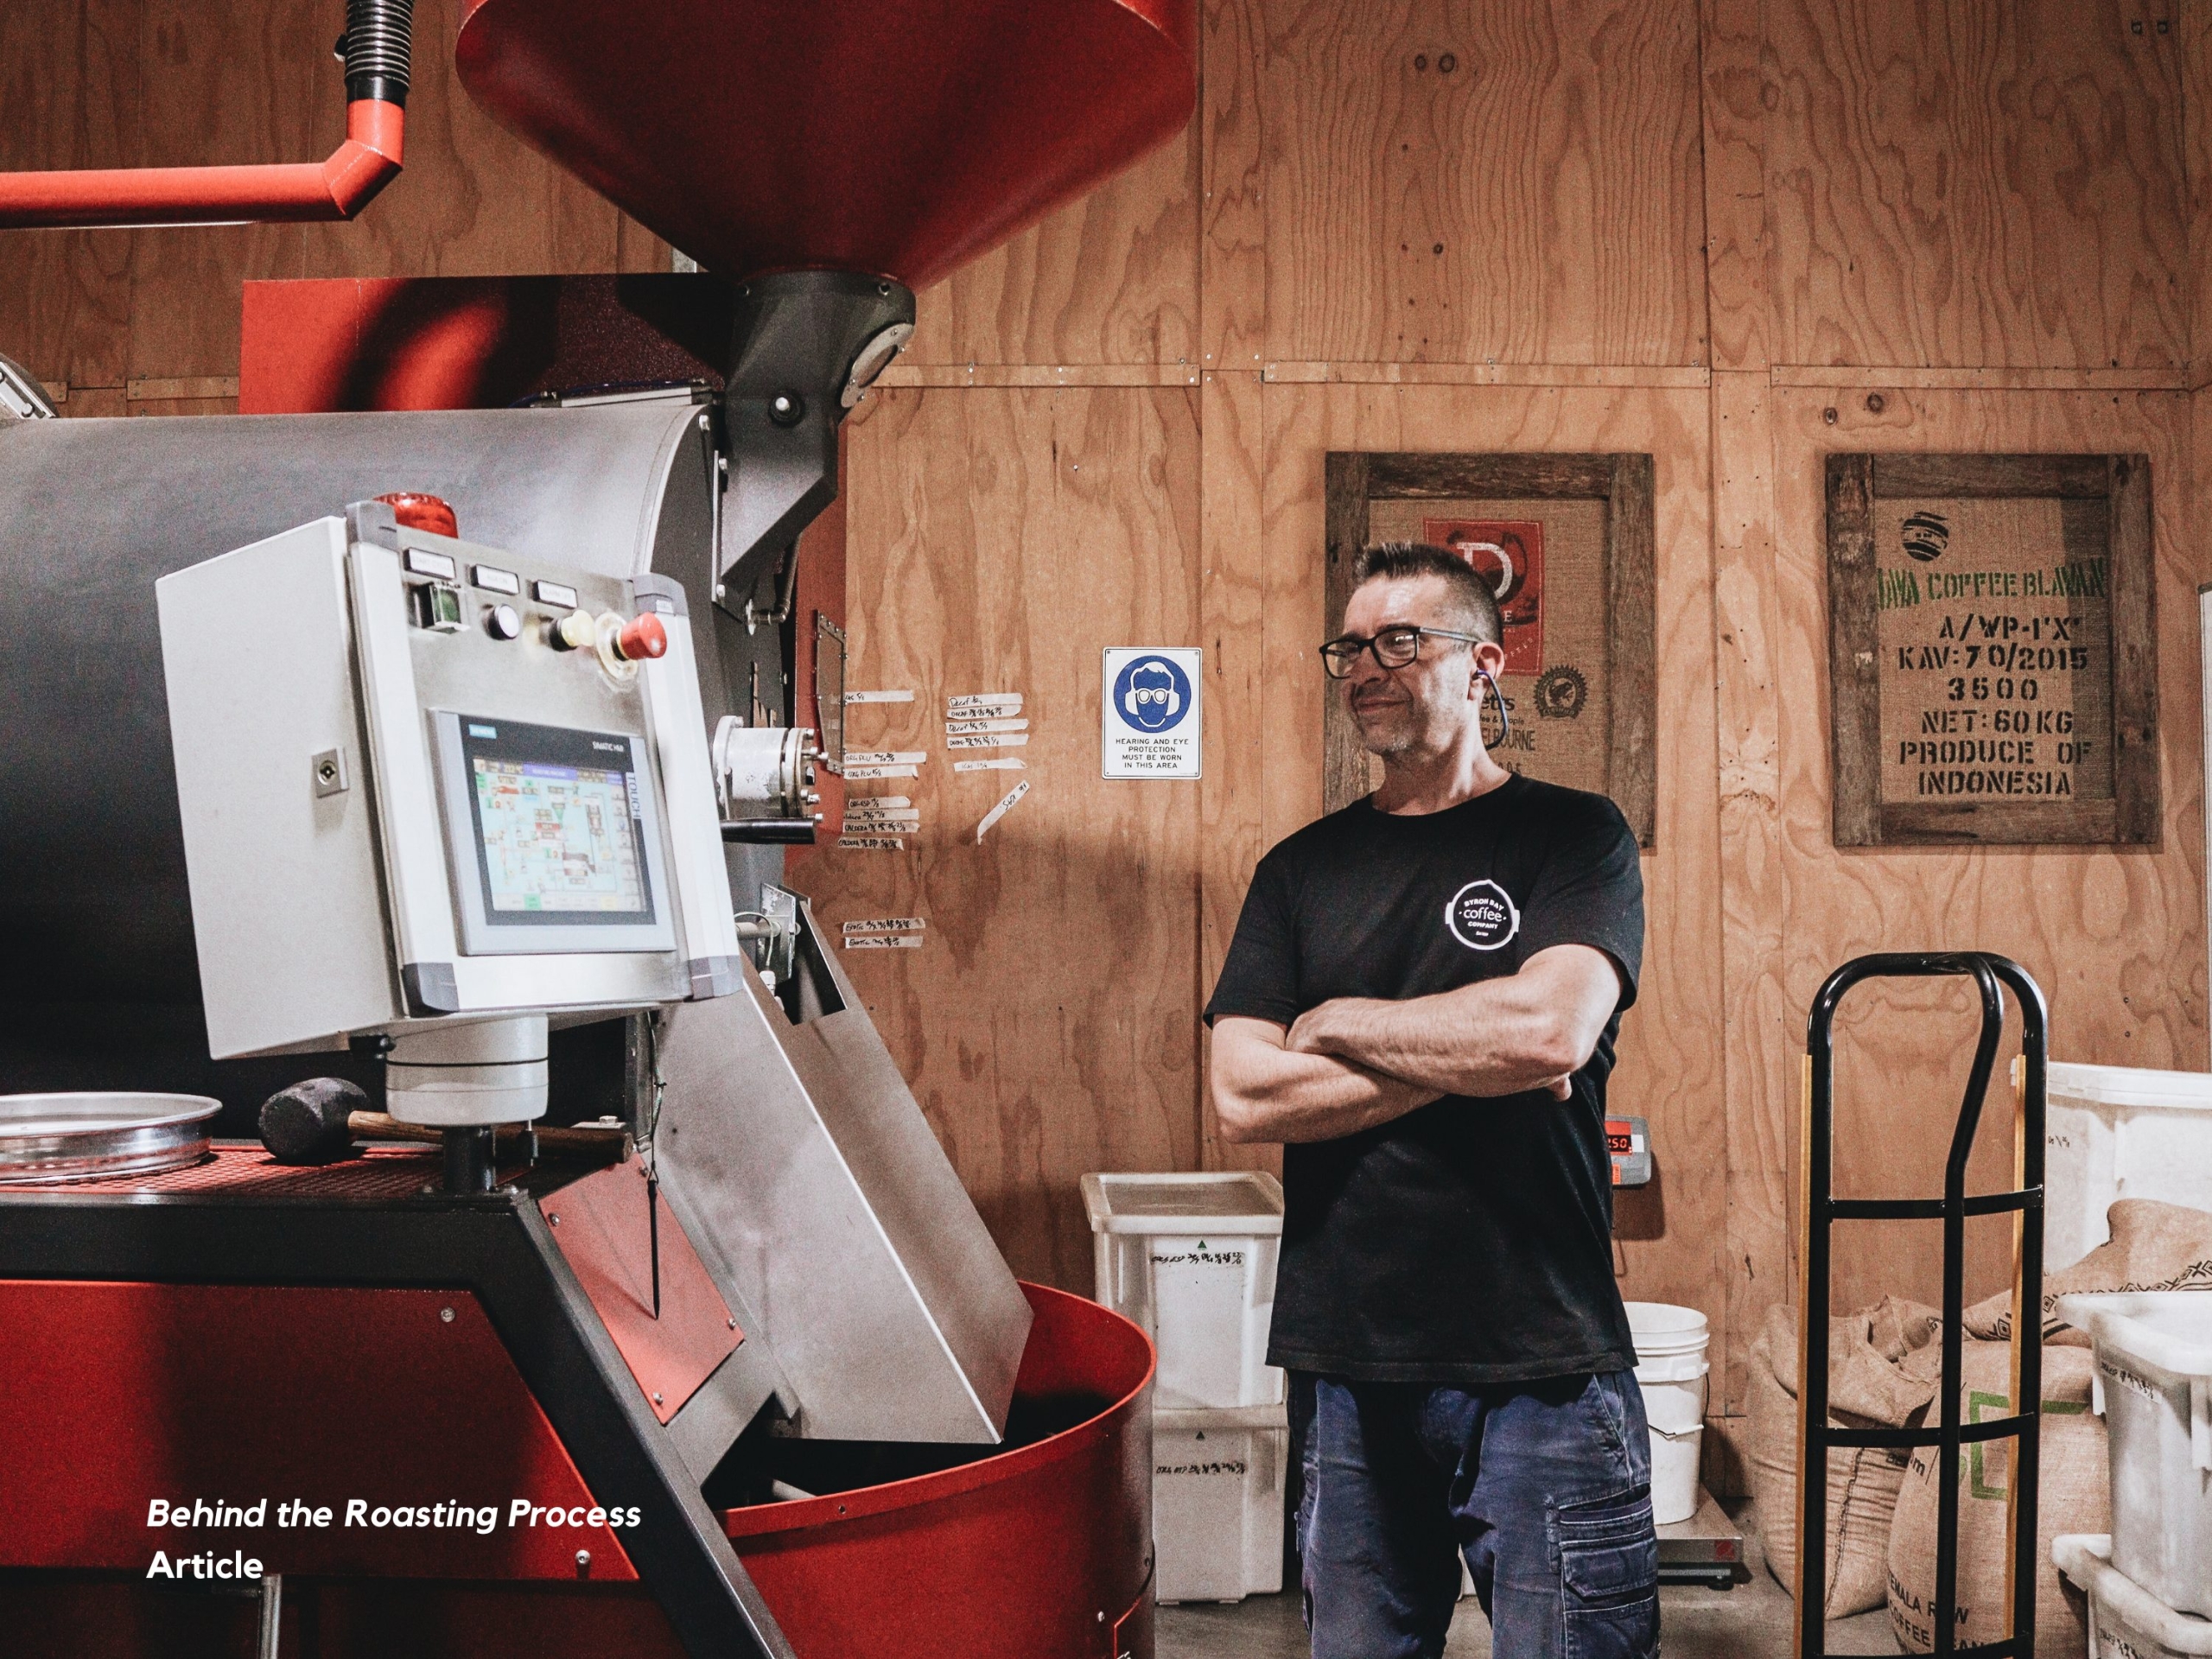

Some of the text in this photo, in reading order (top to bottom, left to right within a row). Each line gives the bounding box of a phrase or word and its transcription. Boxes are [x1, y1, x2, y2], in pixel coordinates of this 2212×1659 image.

[1928, 571, 2018, 600] COFFEE
[1948, 677, 2038, 701] 3500
[1899, 741, 2092, 764] PRODUCE OF
[1918, 771, 2071, 795] INDONESIA
[627, 774, 643, 822] TOUCH
[1463, 906, 1503, 923] coffee
[1464, 898, 1504, 911] BYRON BAY
[1467, 921, 1498, 930] COMPANY
[1889, 1599, 1931, 1648] COFFEE
